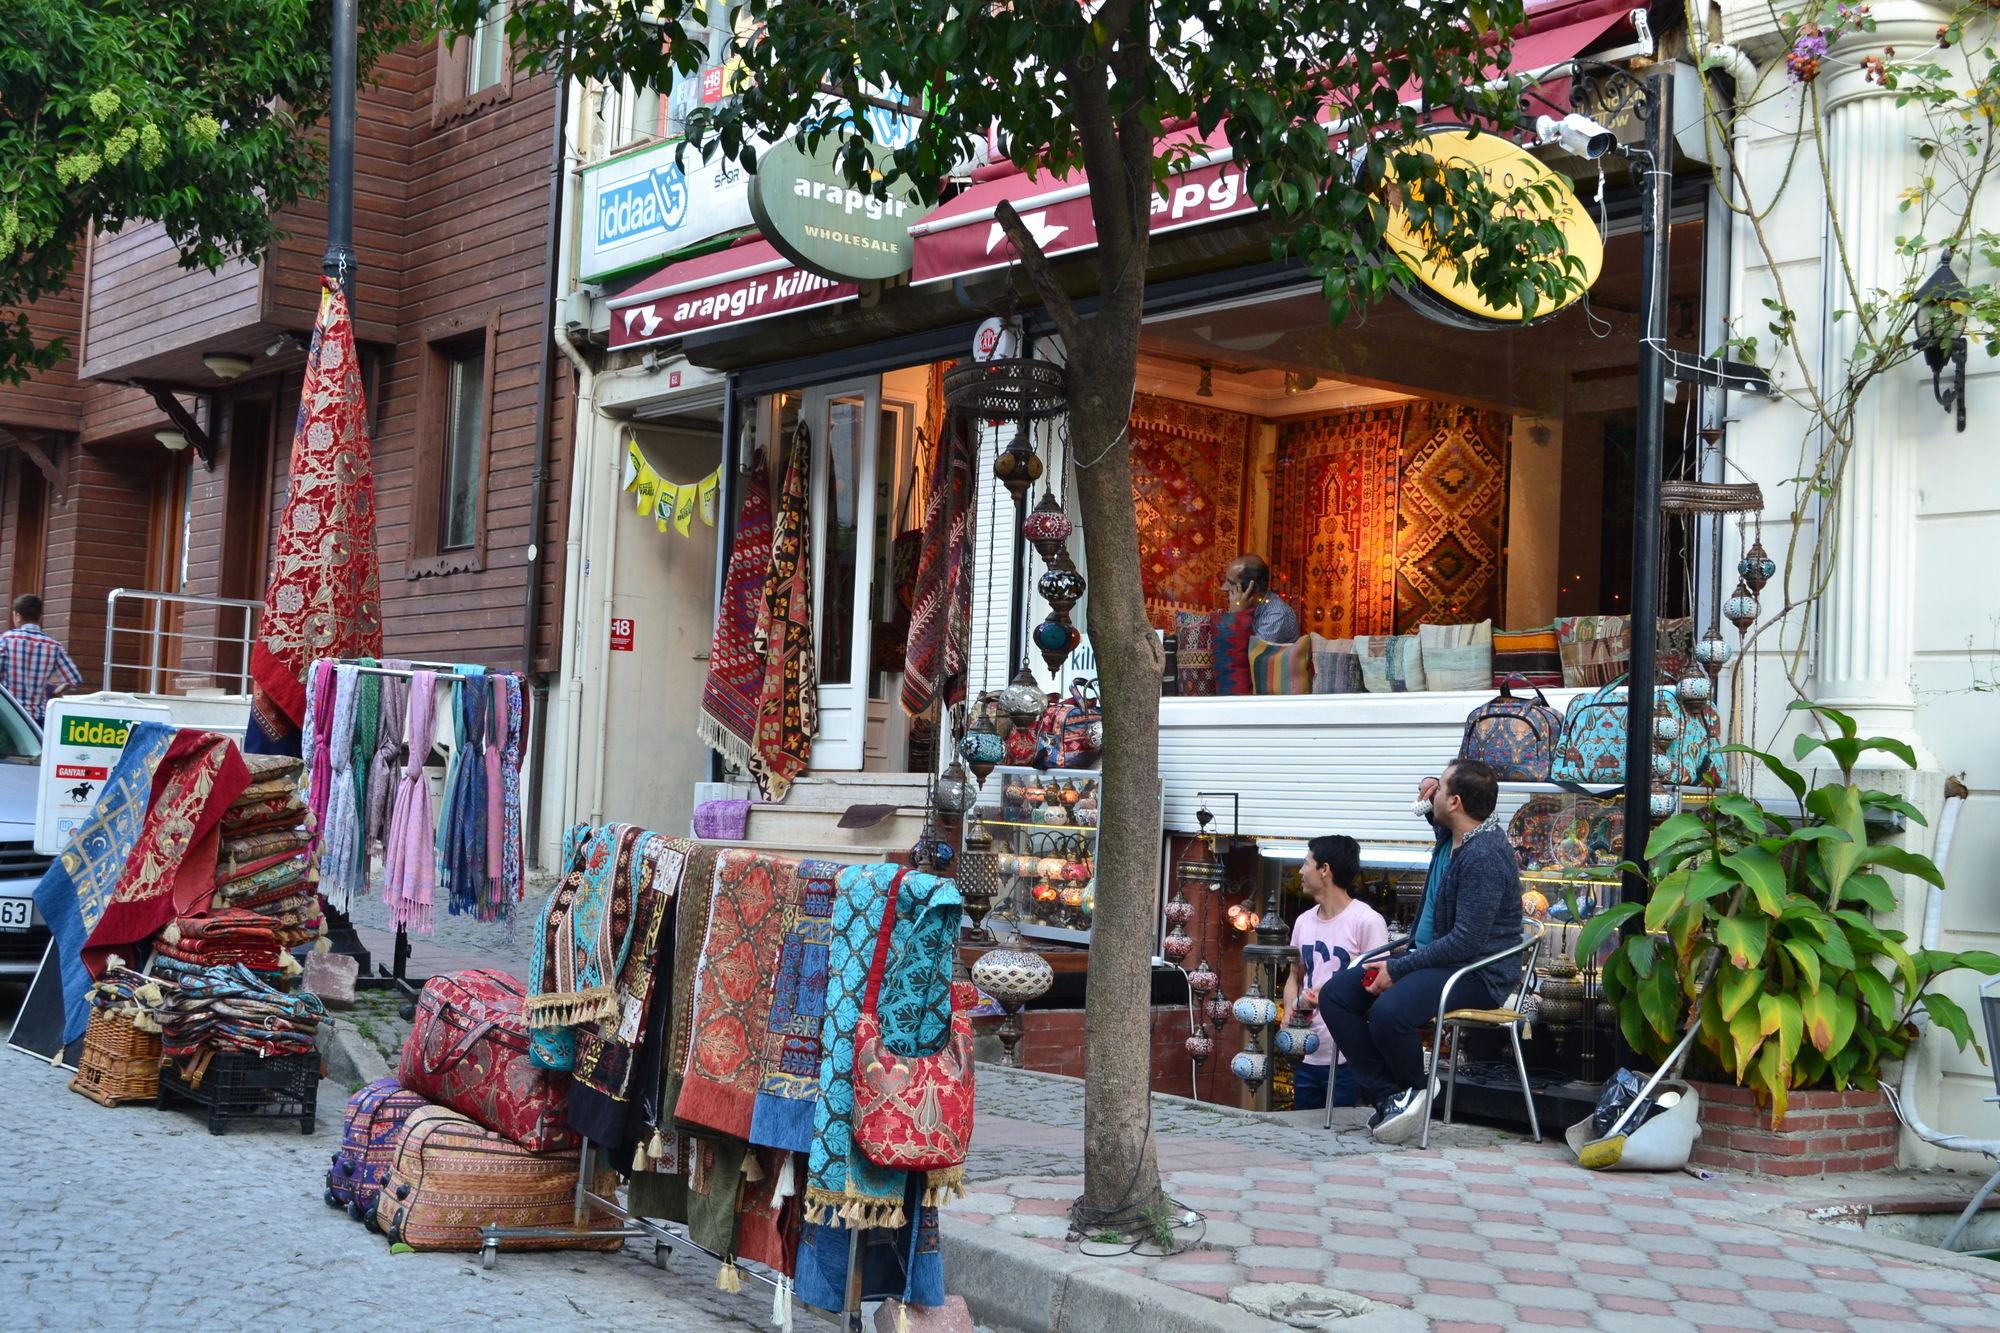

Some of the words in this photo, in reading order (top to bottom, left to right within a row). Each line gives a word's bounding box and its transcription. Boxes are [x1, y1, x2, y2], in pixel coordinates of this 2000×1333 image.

[704, 70, 721, 88] +18
[793, 178, 908, 221] arapgir
[599, 189, 657, 240] iddaa
[804, 224, 899, 254] WHOLESALE
[673, 281, 769, 322] arapgir
[68, 719, 128, 746] iddaa
[58, 767, 86, 777] GANYAN
[1, 902, 27, 924] 63
